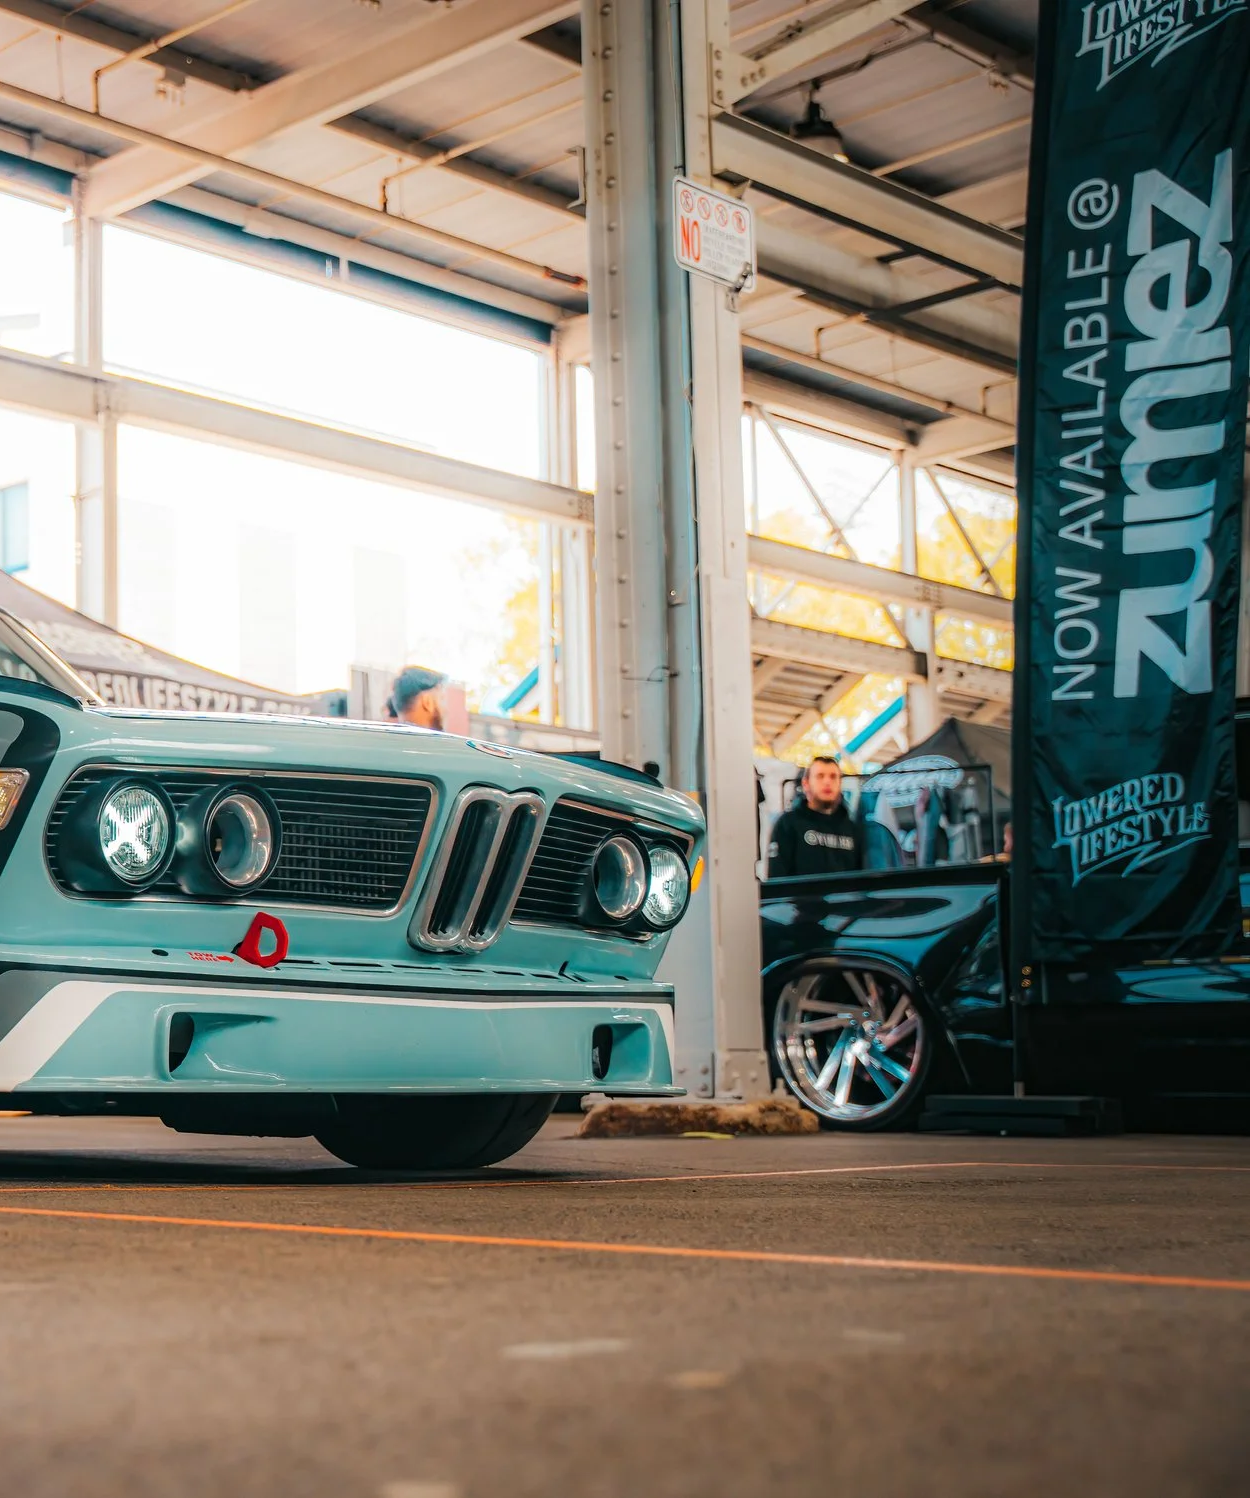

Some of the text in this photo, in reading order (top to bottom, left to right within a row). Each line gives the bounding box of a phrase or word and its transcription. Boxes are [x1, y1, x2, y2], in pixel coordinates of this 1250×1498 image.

[680, 215, 701, 262] NO
[1052, 177, 1120, 701] NOW AVAILABLE @
[1113, 148, 1233, 698] zumiez
[1051, 772, 1185, 849] LOWERED
[1069, 801, 1212, 888] LIFESTYLE
